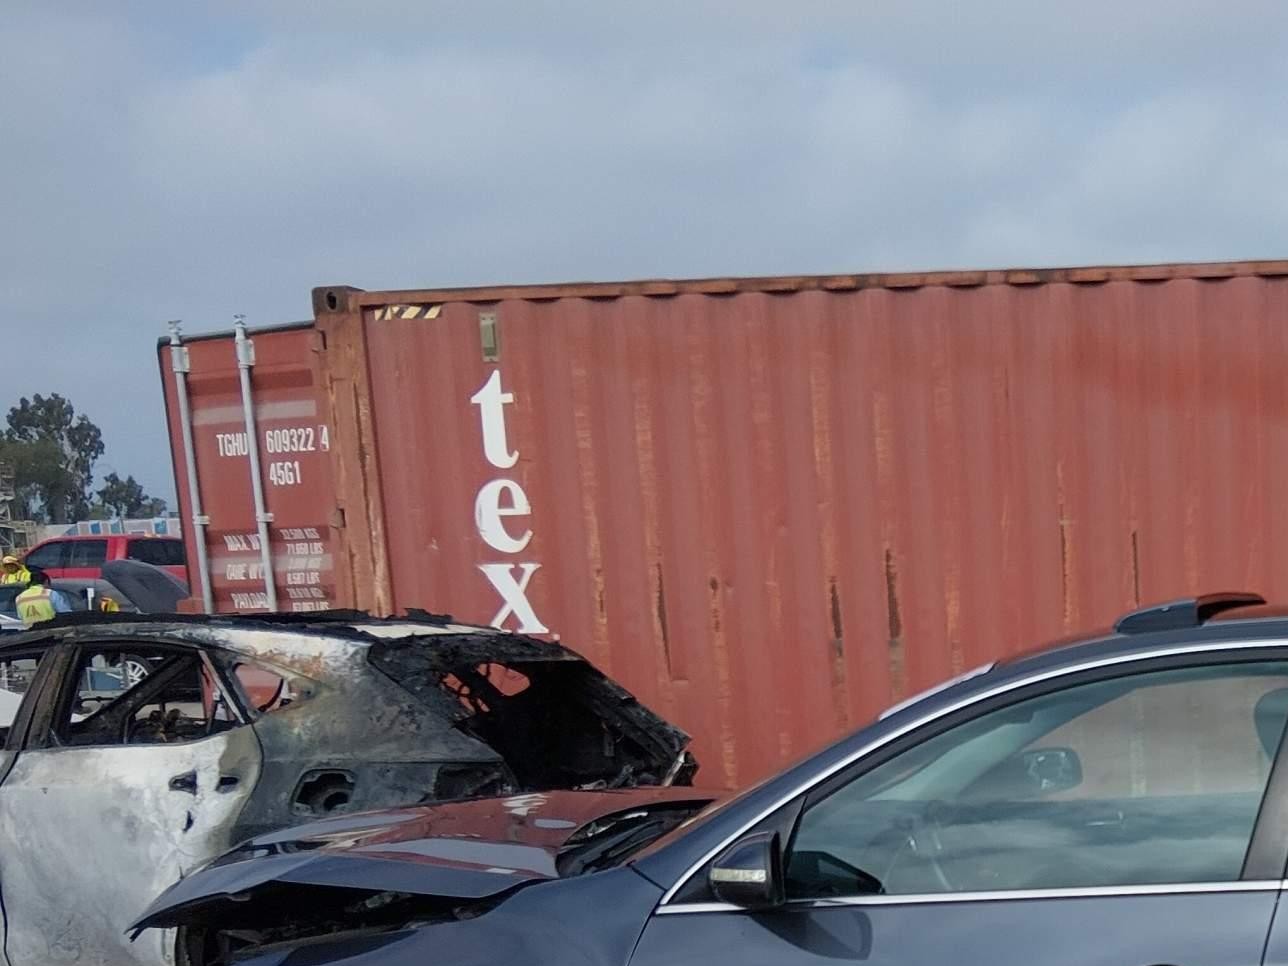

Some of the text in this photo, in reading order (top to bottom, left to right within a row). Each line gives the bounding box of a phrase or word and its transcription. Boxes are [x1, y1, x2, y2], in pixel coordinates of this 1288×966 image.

[216, 424, 330, 457] TGHU 609322 4
[471, 369, 550, 634] tex
